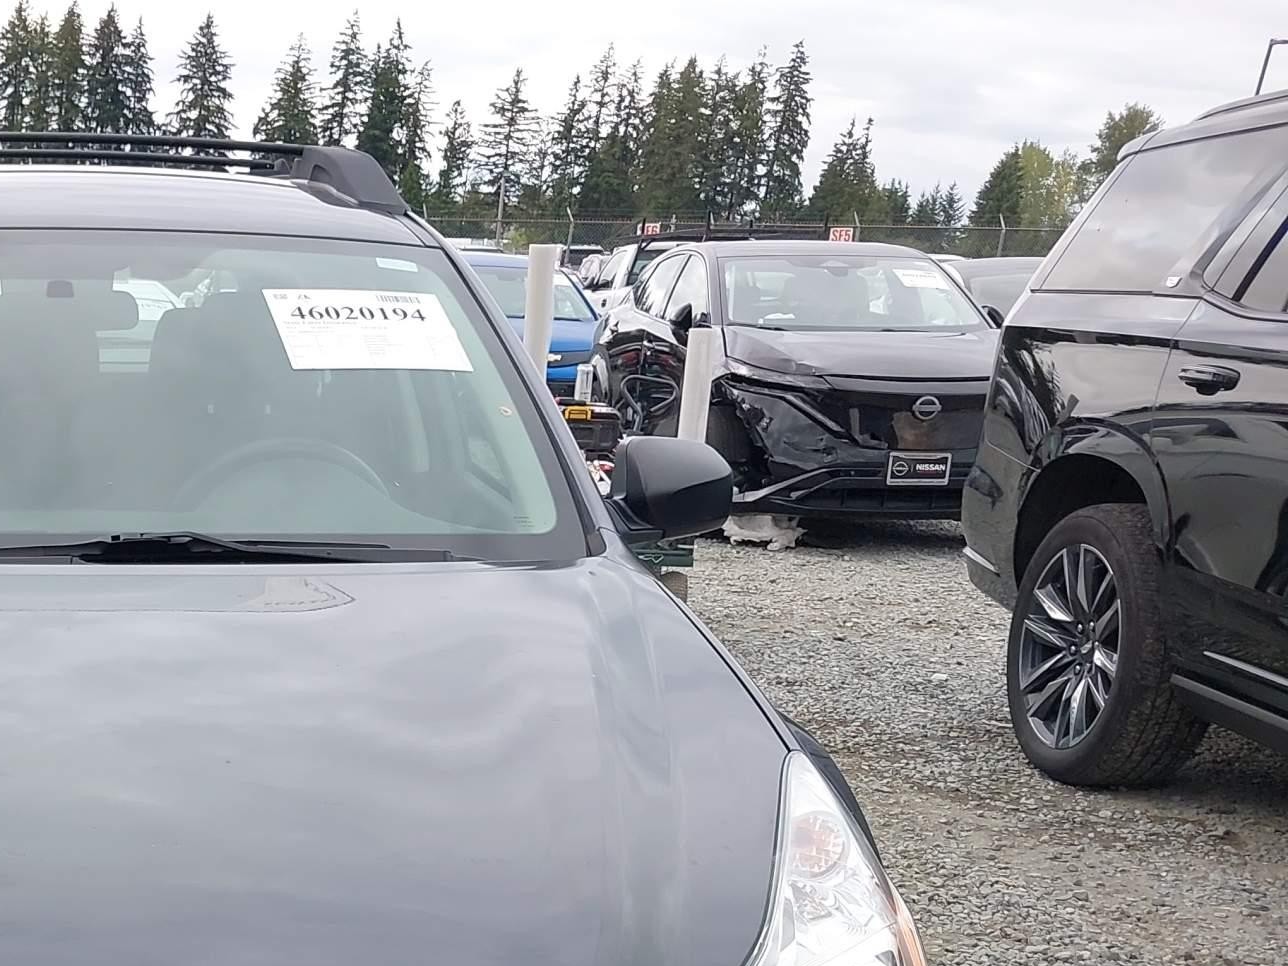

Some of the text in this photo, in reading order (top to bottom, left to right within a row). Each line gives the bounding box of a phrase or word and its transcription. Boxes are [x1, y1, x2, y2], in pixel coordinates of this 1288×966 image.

[831, 229, 852, 241] SF5
[291, 305, 427, 322] 46020194
[915, 463, 946, 472] NISSAN
